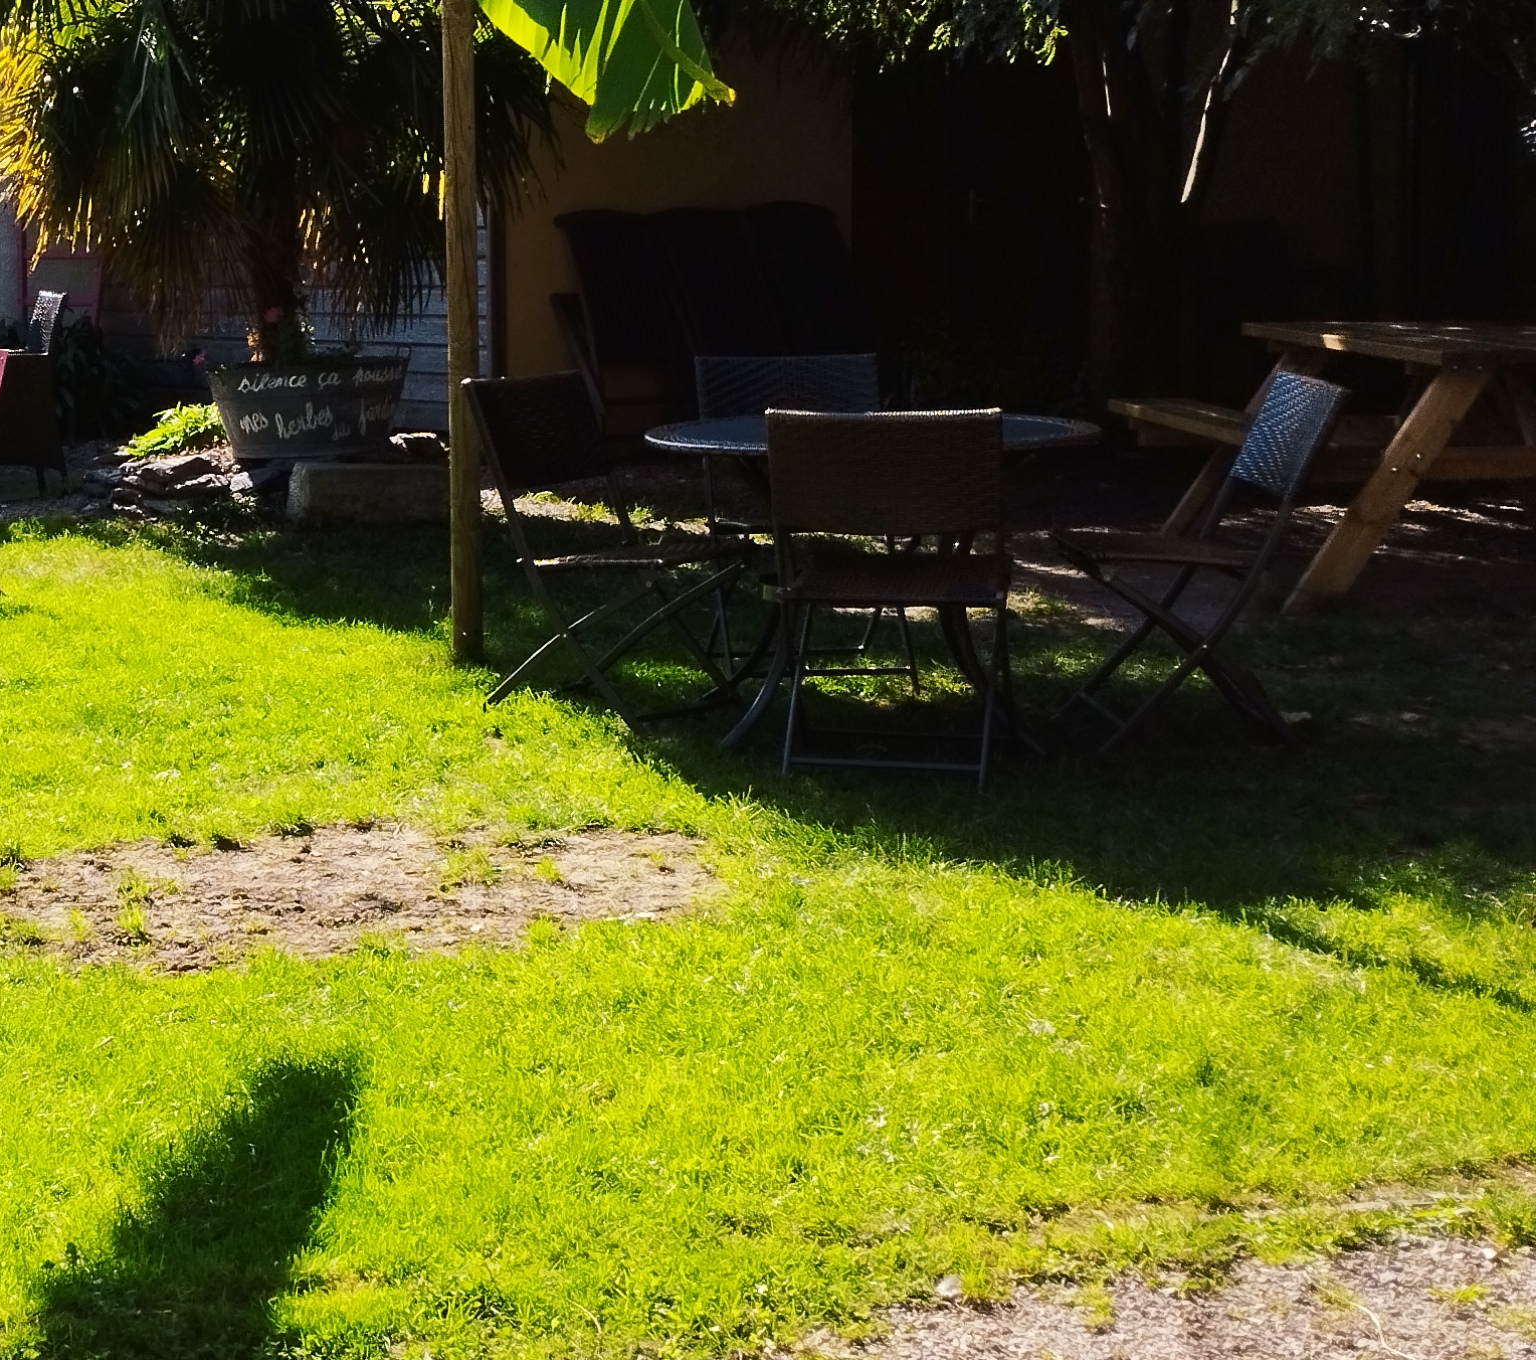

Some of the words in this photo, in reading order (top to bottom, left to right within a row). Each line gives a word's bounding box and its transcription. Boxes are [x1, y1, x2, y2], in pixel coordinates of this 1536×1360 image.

[237, 372, 308, 393] silence
[318, 371, 342, 390] ça
[275, 401, 334, 439] herbes
